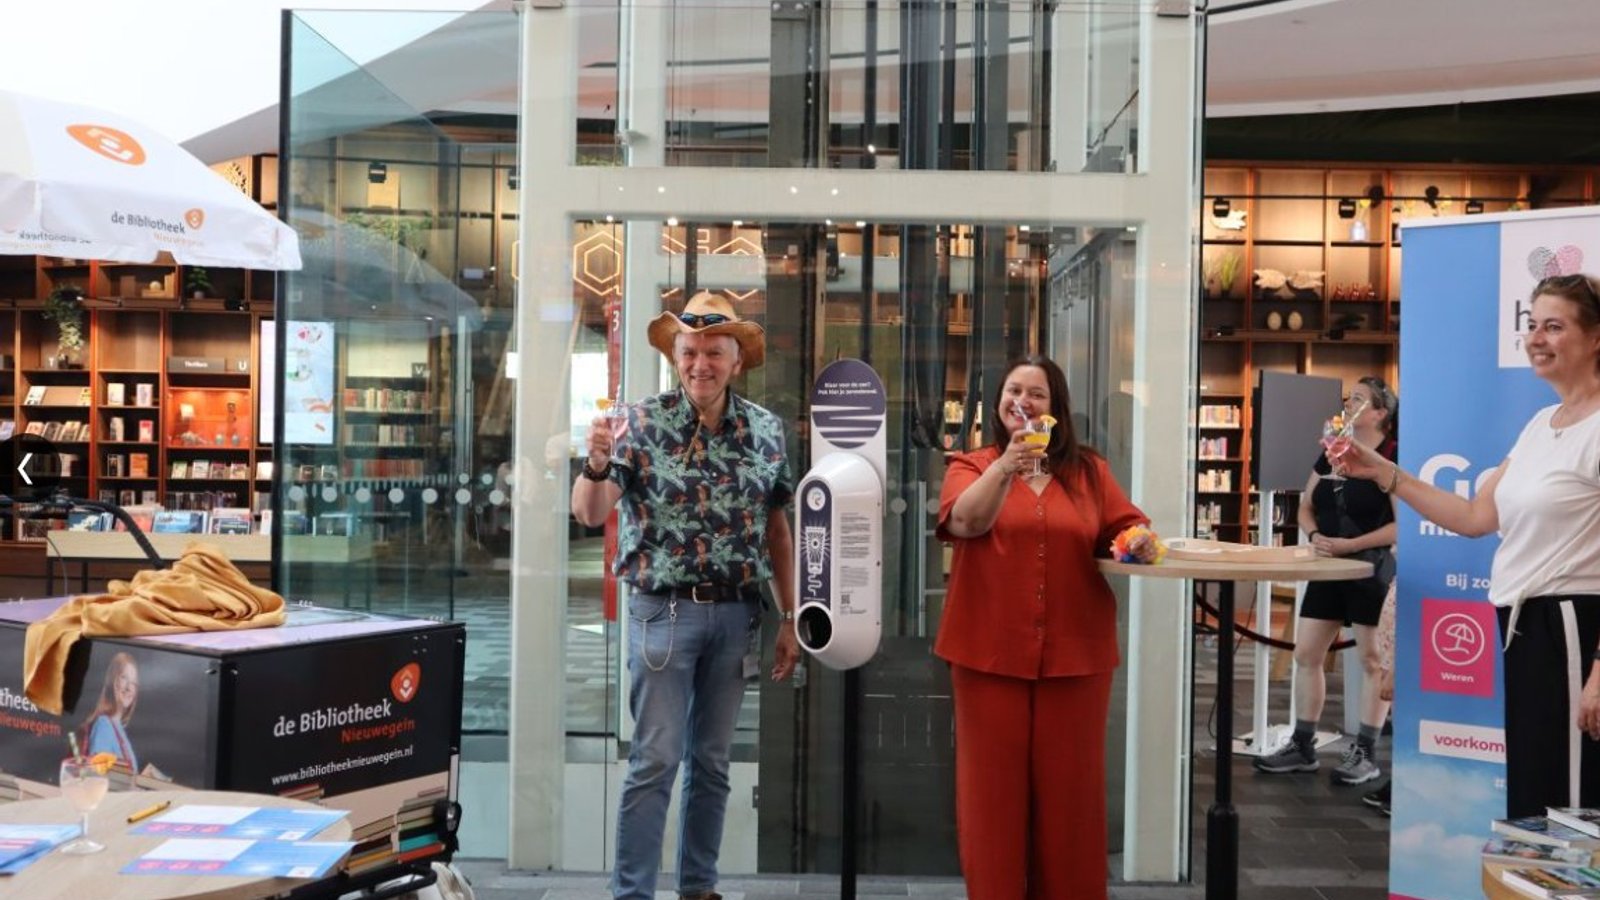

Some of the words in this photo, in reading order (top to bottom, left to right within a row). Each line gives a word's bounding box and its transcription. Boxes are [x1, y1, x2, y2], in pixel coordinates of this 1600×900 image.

[111, 211, 125, 225] de
[127, 213, 186, 235] Bibliotheek
[238, 360, 247, 371] U
[414, 365, 424, 375] V
[1446, 573, 1467, 590] Bij
[1440, 671, 1475, 683] Weren
[273, 715, 296, 737] de
[300, 698, 392, 733] Bibliotheek
[341, 718, 416, 743] Nieuwegein
[271, 744, 413, 785] www.bibliotheeknieuwegein.nl
